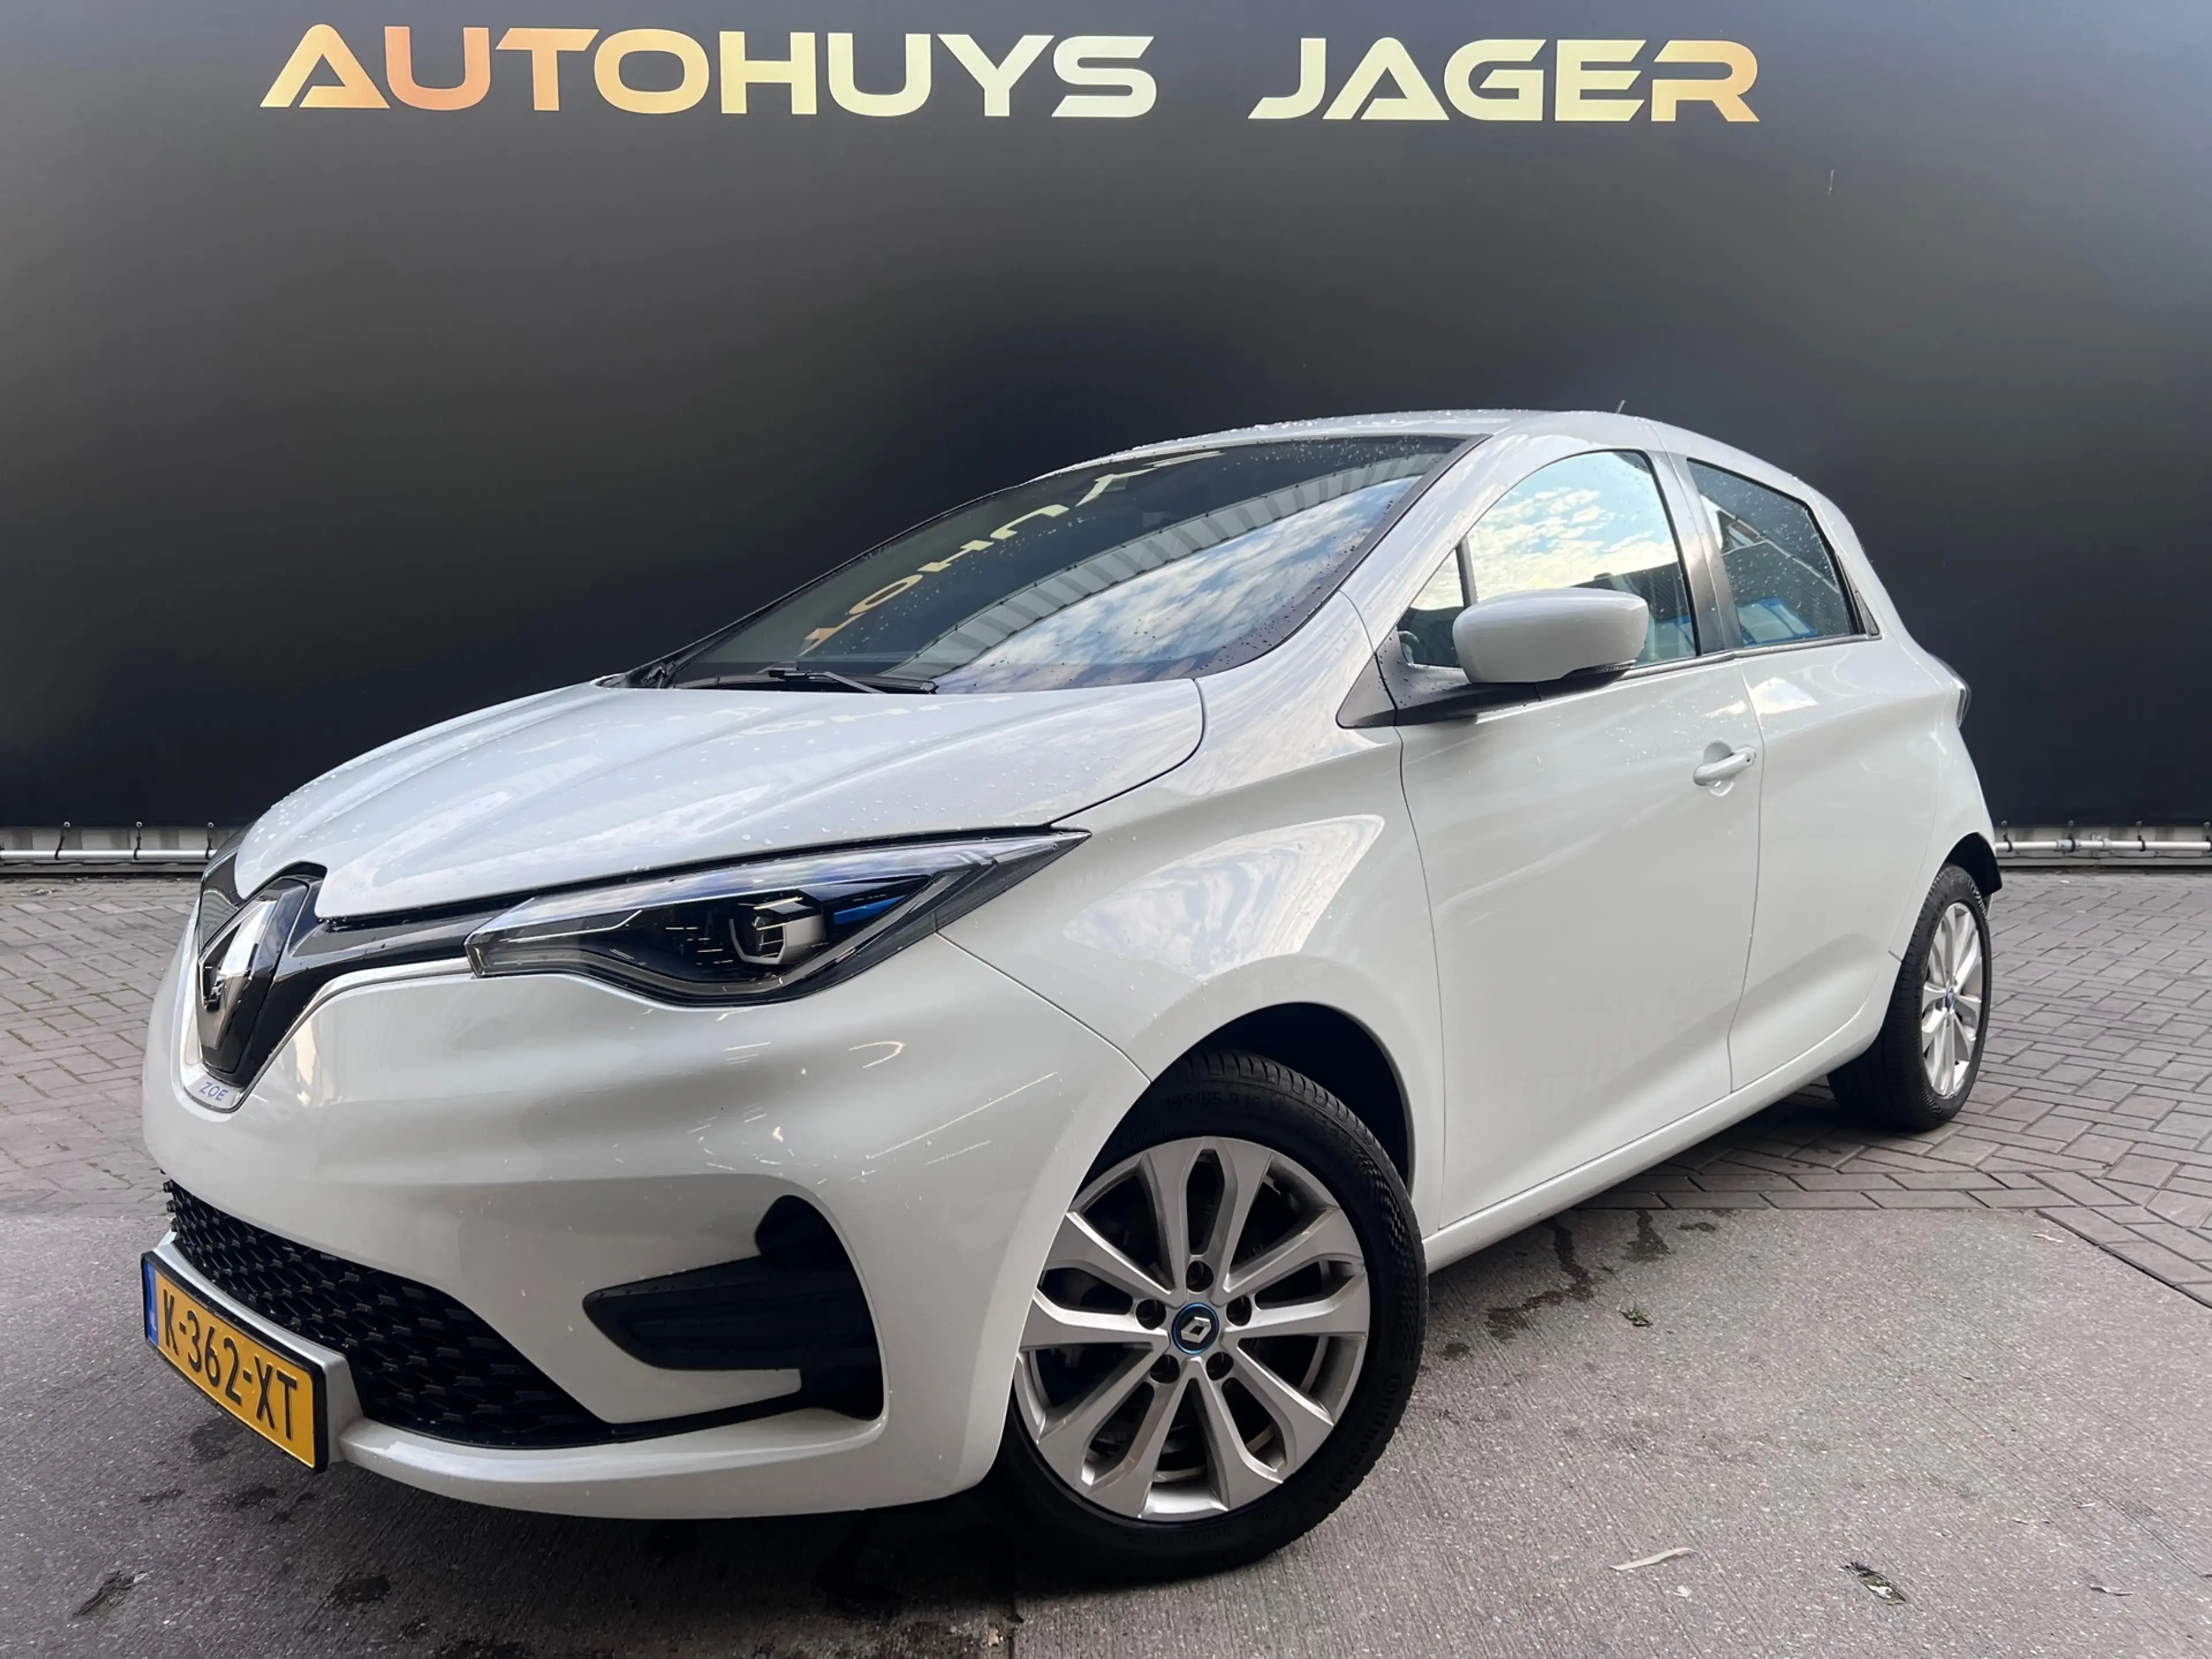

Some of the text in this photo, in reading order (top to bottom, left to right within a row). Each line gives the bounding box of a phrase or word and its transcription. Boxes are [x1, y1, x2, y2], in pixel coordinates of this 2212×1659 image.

[259, 23, 1760, 122] AUTOHUYS JAGER
[199, 1081, 229, 1101] ZOE
[164, 1289, 297, 1440] K-362-XT
[1327, 1374, 1403, 1493] Continental
